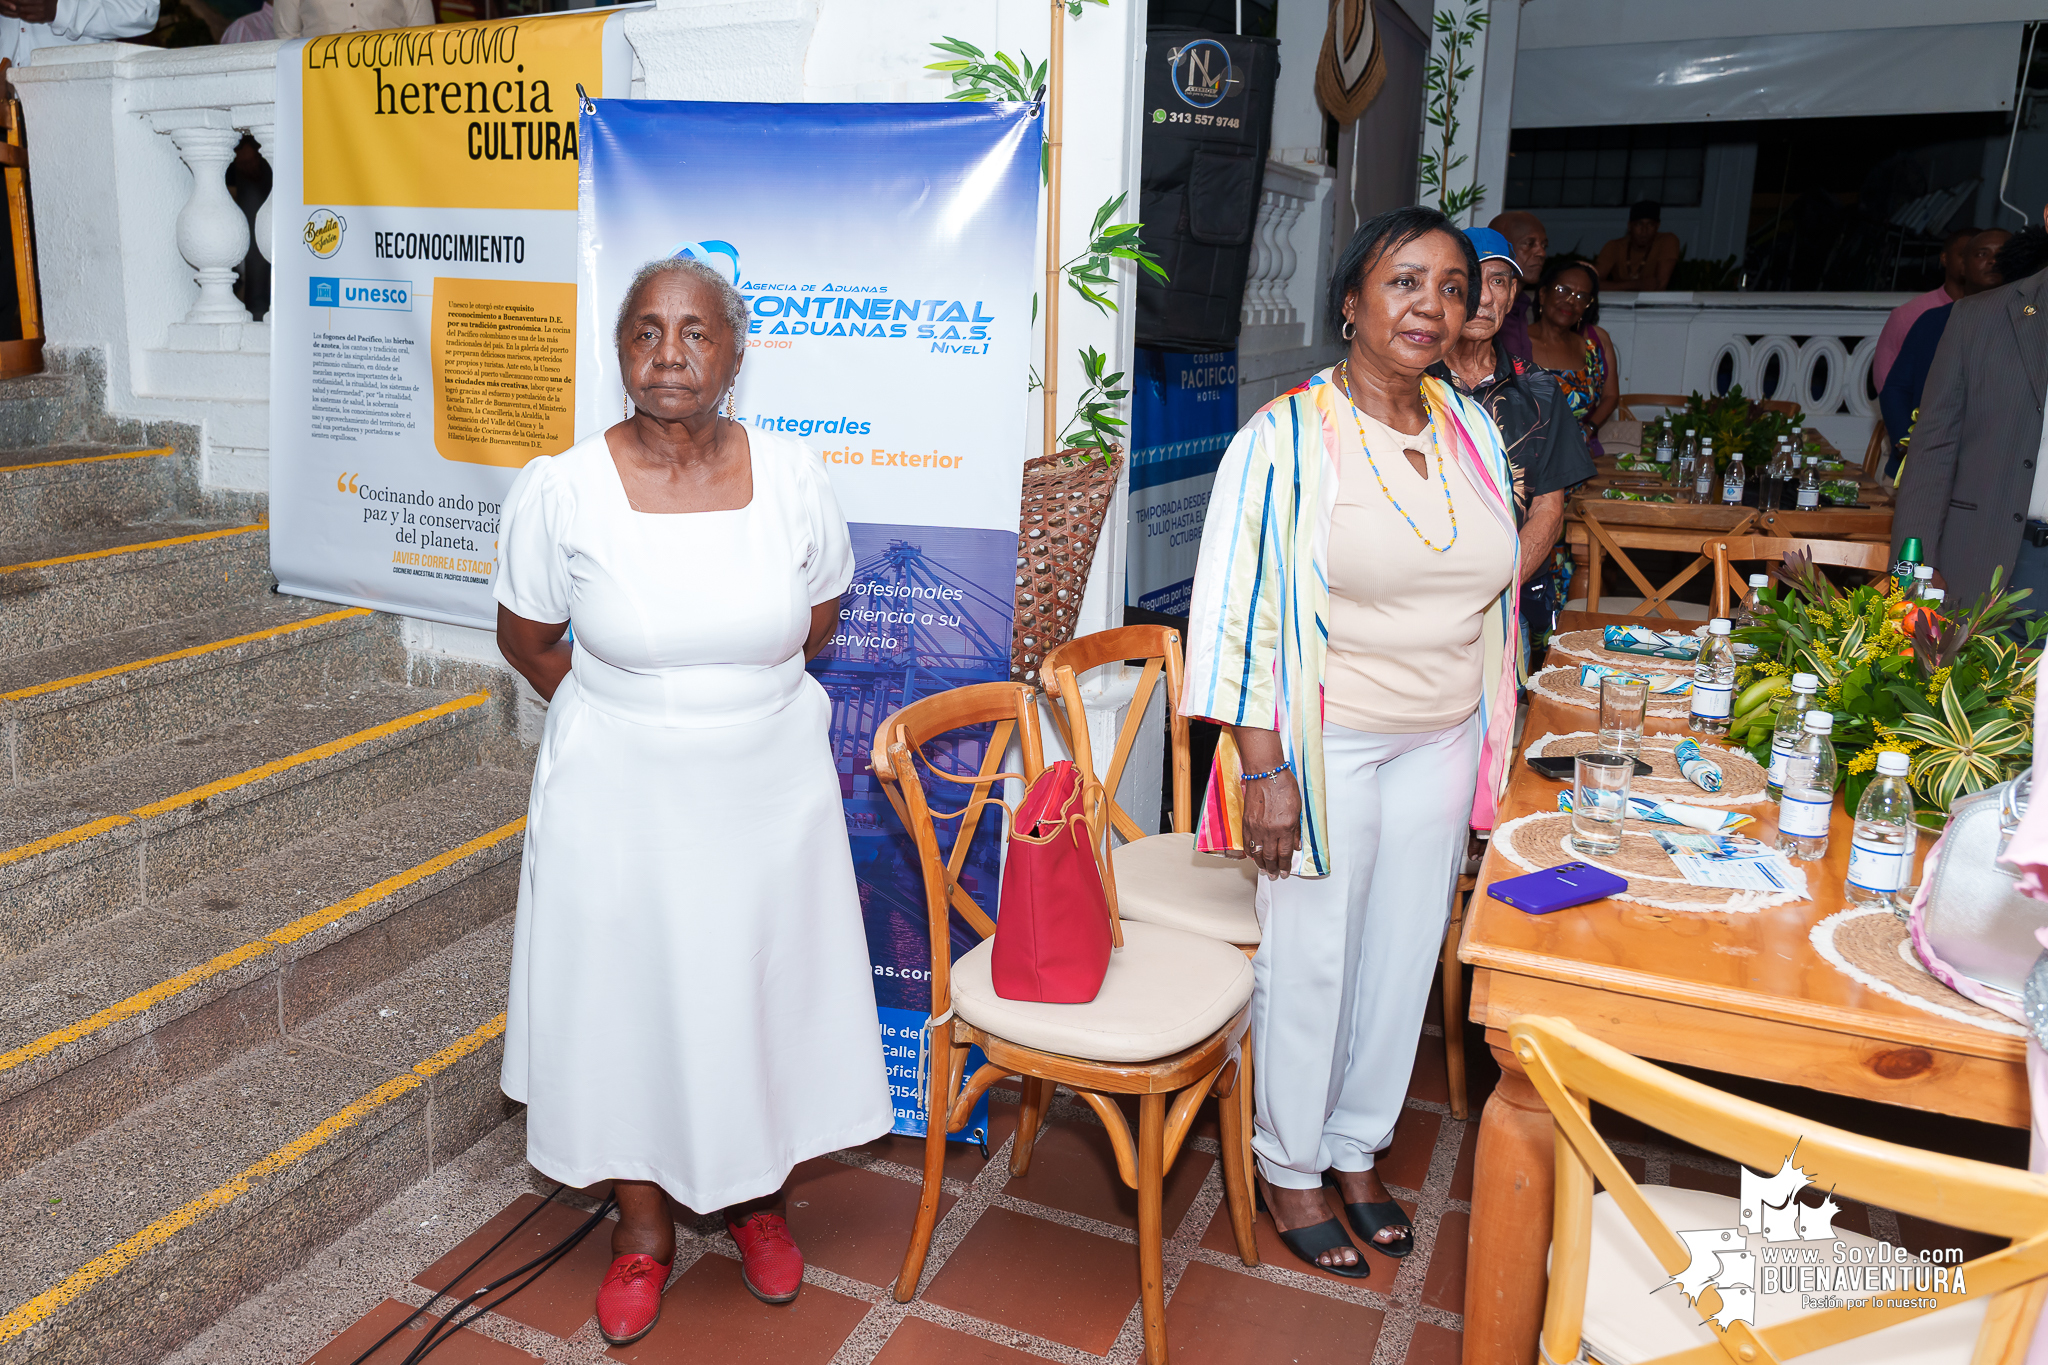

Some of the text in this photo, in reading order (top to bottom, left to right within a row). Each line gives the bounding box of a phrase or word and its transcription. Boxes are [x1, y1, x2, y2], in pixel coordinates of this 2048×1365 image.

[309, 25, 519, 69] LA COCINA COMO
[373, 64, 553, 115] herencia
[1169, 112, 1240, 128] 313 557 9748
[468, 121, 578, 160] CULTURA
[374, 231, 525, 264] RECONOCIMIENTO
[345, 287, 407, 304] unesco
[549, 316, 563, 324] D.E.
[748, 320, 992, 341] E ADUANAS S.A.S.
[745, 339, 761, 348] OD
[1193, 352, 1224, 364] COSMOS
[1181, 365, 1236, 390] PACIFICO
[1197, 390, 1220, 402] HOTEL
[755, 415, 871, 437] Integrales
[822, 446, 963, 469] rcio Exterior
[359, 485, 501, 516] Cocinando ando por
[1136, 499, 1182, 523] TEMPORADA
[1183, 492, 1206, 510] DESDE
[363, 507, 500, 534] paz y la conservació
[1147, 519, 1171, 537] JULIO
[1171, 513, 1195, 530] HASTA
[1196, 509, 1204, 523] EL
[395, 527, 479, 551] del planeta.
[1170, 526, 1202, 547] OCTUBRE
[392, 551, 492, 575] JAVIER CORREA ESTACIO
[393, 567, 412, 575] COCINERO
[413, 569, 435, 578] ANCESTRAL
[462, 575, 489, 585] COLOMBIANO
[848, 581, 963, 601] rofesionales
[1171, 589, 1181, 604] por
[1183, 585, 1191, 597] los
[840, 606, 961, 627] eriencia a su
[1163, 598, 1191, 615] speciale
[828, 633, 897, 649] servicio
[874, 965, 932, 981] as.co
[879, 1024, 896, 1037] lle
[882, 1044, 916, 1059] Calle
[886, 1065, 929, 1080] ofici
[893, 1108, 929, 1121] anas
